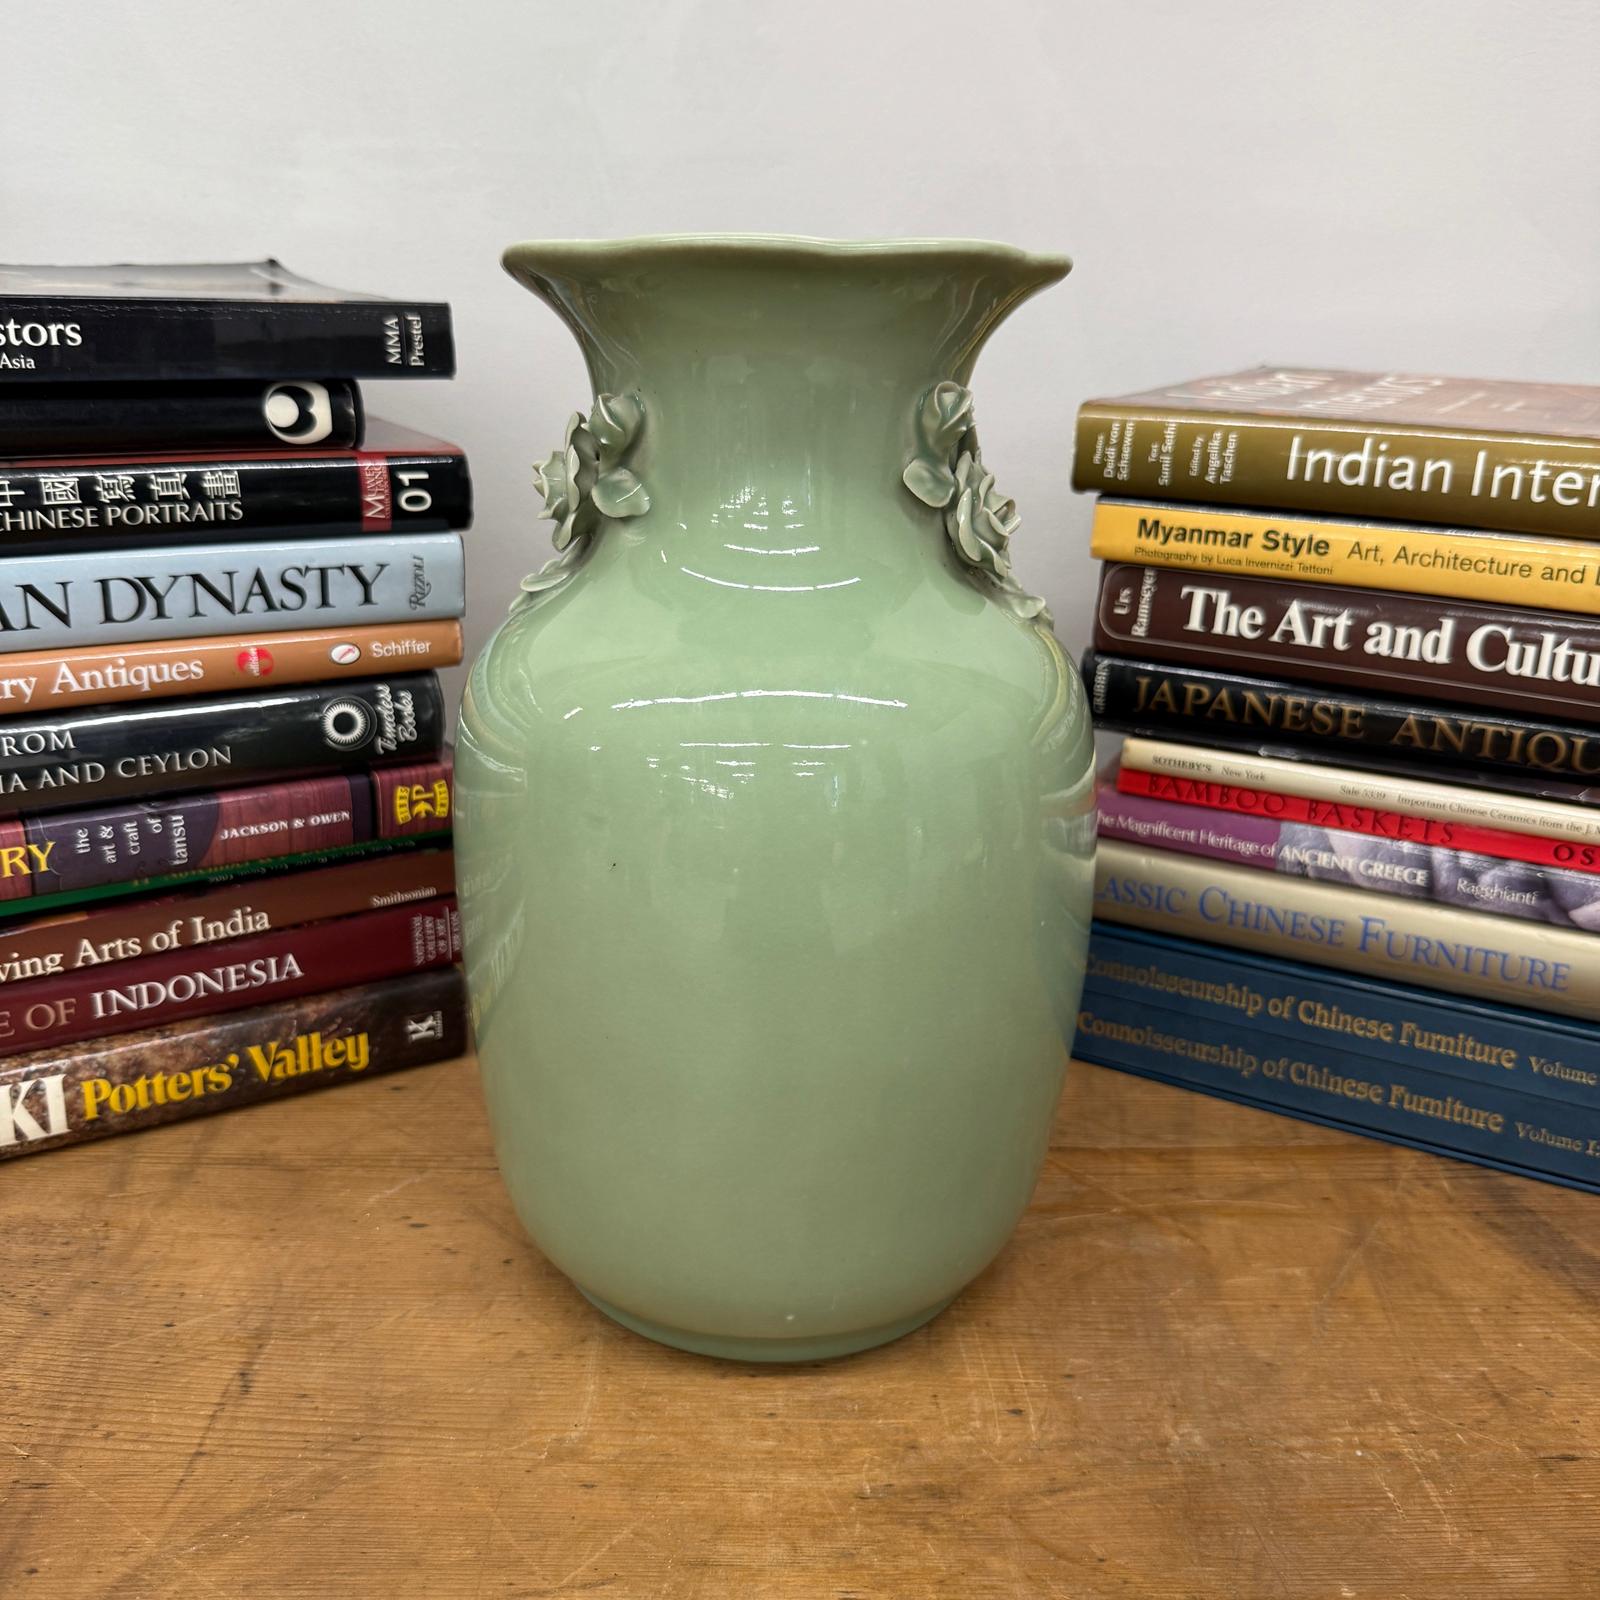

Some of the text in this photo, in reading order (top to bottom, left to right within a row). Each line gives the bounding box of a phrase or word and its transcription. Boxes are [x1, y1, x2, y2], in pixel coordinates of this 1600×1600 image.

[0, 352, 36, 369] Asia
[384, 315, 402, 365] MMA
[406, 310, 425, 367] Prestel
[1109, 421, 1121, 446] von
[1205, 429, 1223, 484] Angelika
[1158, 452, 1173, 487] Sunil
[1219, 431, 1239, 485] Taschen
[1286, 434, 1600, 509] Indian Inter
[396, 470, 432, 512] 01
[0, 500, 244, 532] HINESE PORTRAITS
[1134, 546, 1334, 576] Photography by Luca Invernizzi Tettoni
[1136, 517, 1254, 549] Myanmar
[1261, 529, 1331, 559] Style
[1347, 540, 1385, 567] Art,
[1393, 546, 1532, 579] Architecture
[1540, 564, 1587, 585] and
[94, 563, 390, 625] DYNASTY
[1113, 586, 1133, 616] Urs
[1130, 568, 1158, 638] Ramseyer
[371, 640, 433, 659] Schiffer
[1180, 585, 1600, 688] The Art and Cultu
[0, 658, 205, 704] ry Antiques
[1132, 676, 1366, 740] JAPANESE
[1391, 714, 1600, 774] ANTIQU
[38, 762, 106, 790] AND
[117, 745, 233, 779] CEYLON
[1220, 767, 1242, 778] New
[1244, 770, 1267, 782] York
[146, 817, 163, 835] of
[220, 810, 351, 841] JACKSON & OWEN
[1147, 774, 1289, 816] BAMBOO
[1306, 799, 1454, 844] BASKETS
[1396, 794, 1447, 813] Important
[1448, 800, 1489, 818] Chinese
[1489, 808, 1539, 827] Ceramics
[1538, 815, 1565, 832] from
[1566, 820, 1584, 835] the
[0, 841, 56, 879] RY
[75, 827, 92, 855] the
[99, 824, 118, 865] art &
[122, 820, 141, 856] craft
[169, 814, 189, 866] tansu
[1097, 808, 1430, 888] he Magnificent Heritage of ANCIENT GREECE
[371, 885, 438, 908] Smithsonian
[75, 935, 143, 969] Arts
[151, 919, 184, 951] of
[191, 905, 272, 945] India
[1096, 876, 1571, 992] ASSIC CHINESE FURNITURE
[25, 997, 78, 1031] OF
[90, 952, 304, 1019] INDONESIA
[1267, 996, 1297, 1020] of
[1298, 999, 1394, 1044] Chinese
[1399, 1020, 1518, 1070] Furniture
[1528, 1055, 1598, 1086] Volume
[0, 1031, 370, 1147] KI Potters' Valley
[1076, 1011, 1258, 1078] Connoisseurship
[1262, 1057, 1291, 1081] of
[1289, 1061, 1384, 1104] Chinese
[1388, 1082, 1505, 1133] Furniture
[1514, 1120, 1583, 1152] Volume
